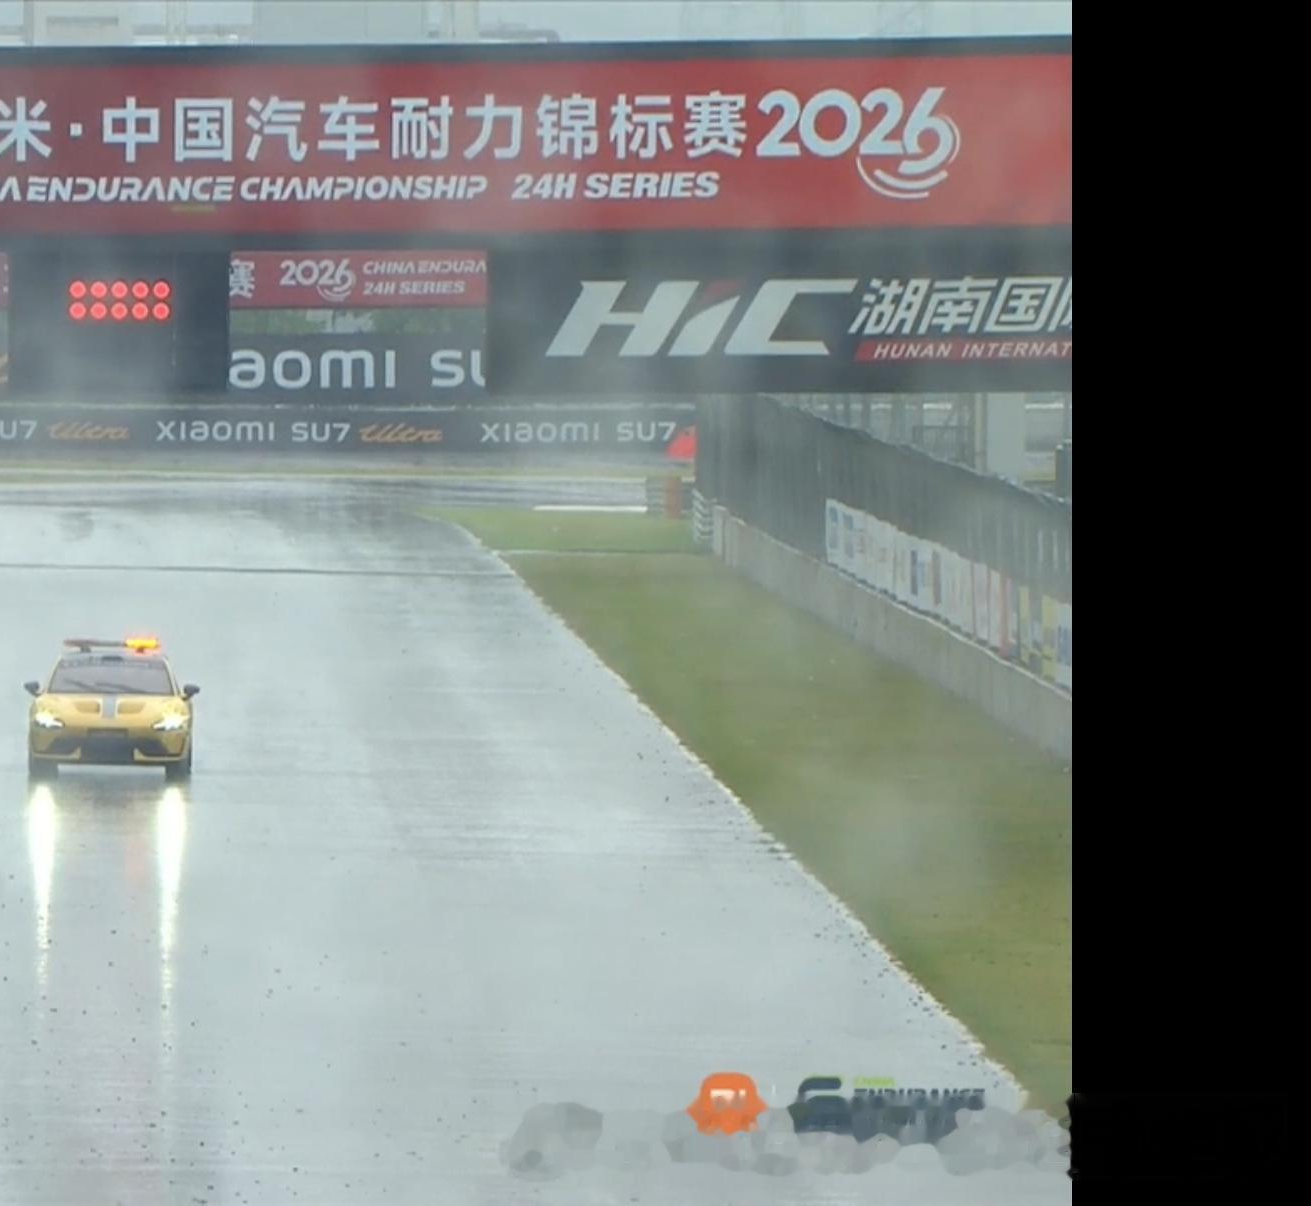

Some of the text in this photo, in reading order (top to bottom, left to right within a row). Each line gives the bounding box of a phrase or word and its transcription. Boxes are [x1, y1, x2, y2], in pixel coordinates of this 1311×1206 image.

[755, 86, 961, 198] 2026
[25, 176, 235, 202] ENDURANCE
[240, 175, 487, 201] CHAMPIONSHIP
[511, 173, 576, 200] 24H
[583, 171, 721, 198] SERIES
[279, 257, 357, 302] 2026
[362, 260, 415, 275] CHINA
[362, 280, 466, 295] 24H SERIES
[873, 341, 952, 360] HUNAN
[48, 421, 131, 441] Ultra
[291, 422, 351, 442] SU7
[359, 422, 443, 444] Ultra
[616, 421, 677, 442] SU7
